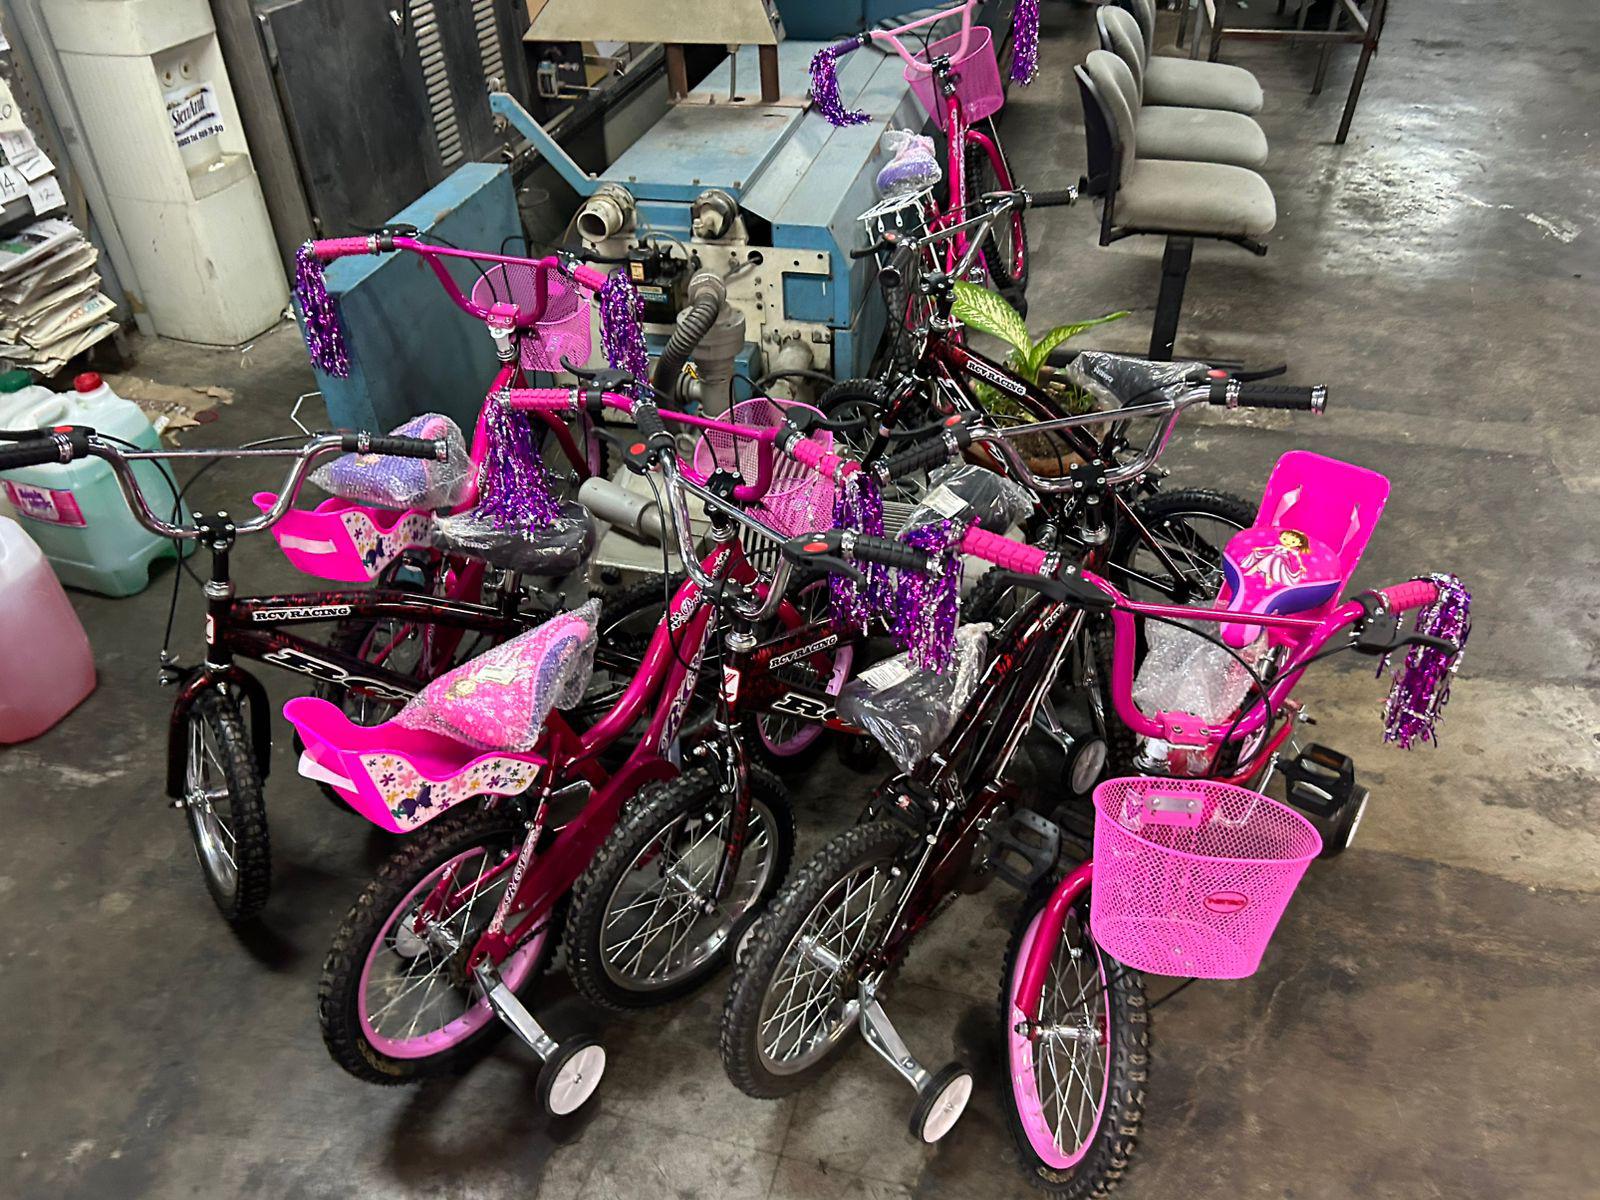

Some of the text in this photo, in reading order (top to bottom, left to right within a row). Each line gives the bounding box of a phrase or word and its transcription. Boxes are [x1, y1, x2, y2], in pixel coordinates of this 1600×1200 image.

[985, 371, 1027, 396] RACING
[289, 605, 351, 619] RACING
[794, 634, 838, 659] RACING
